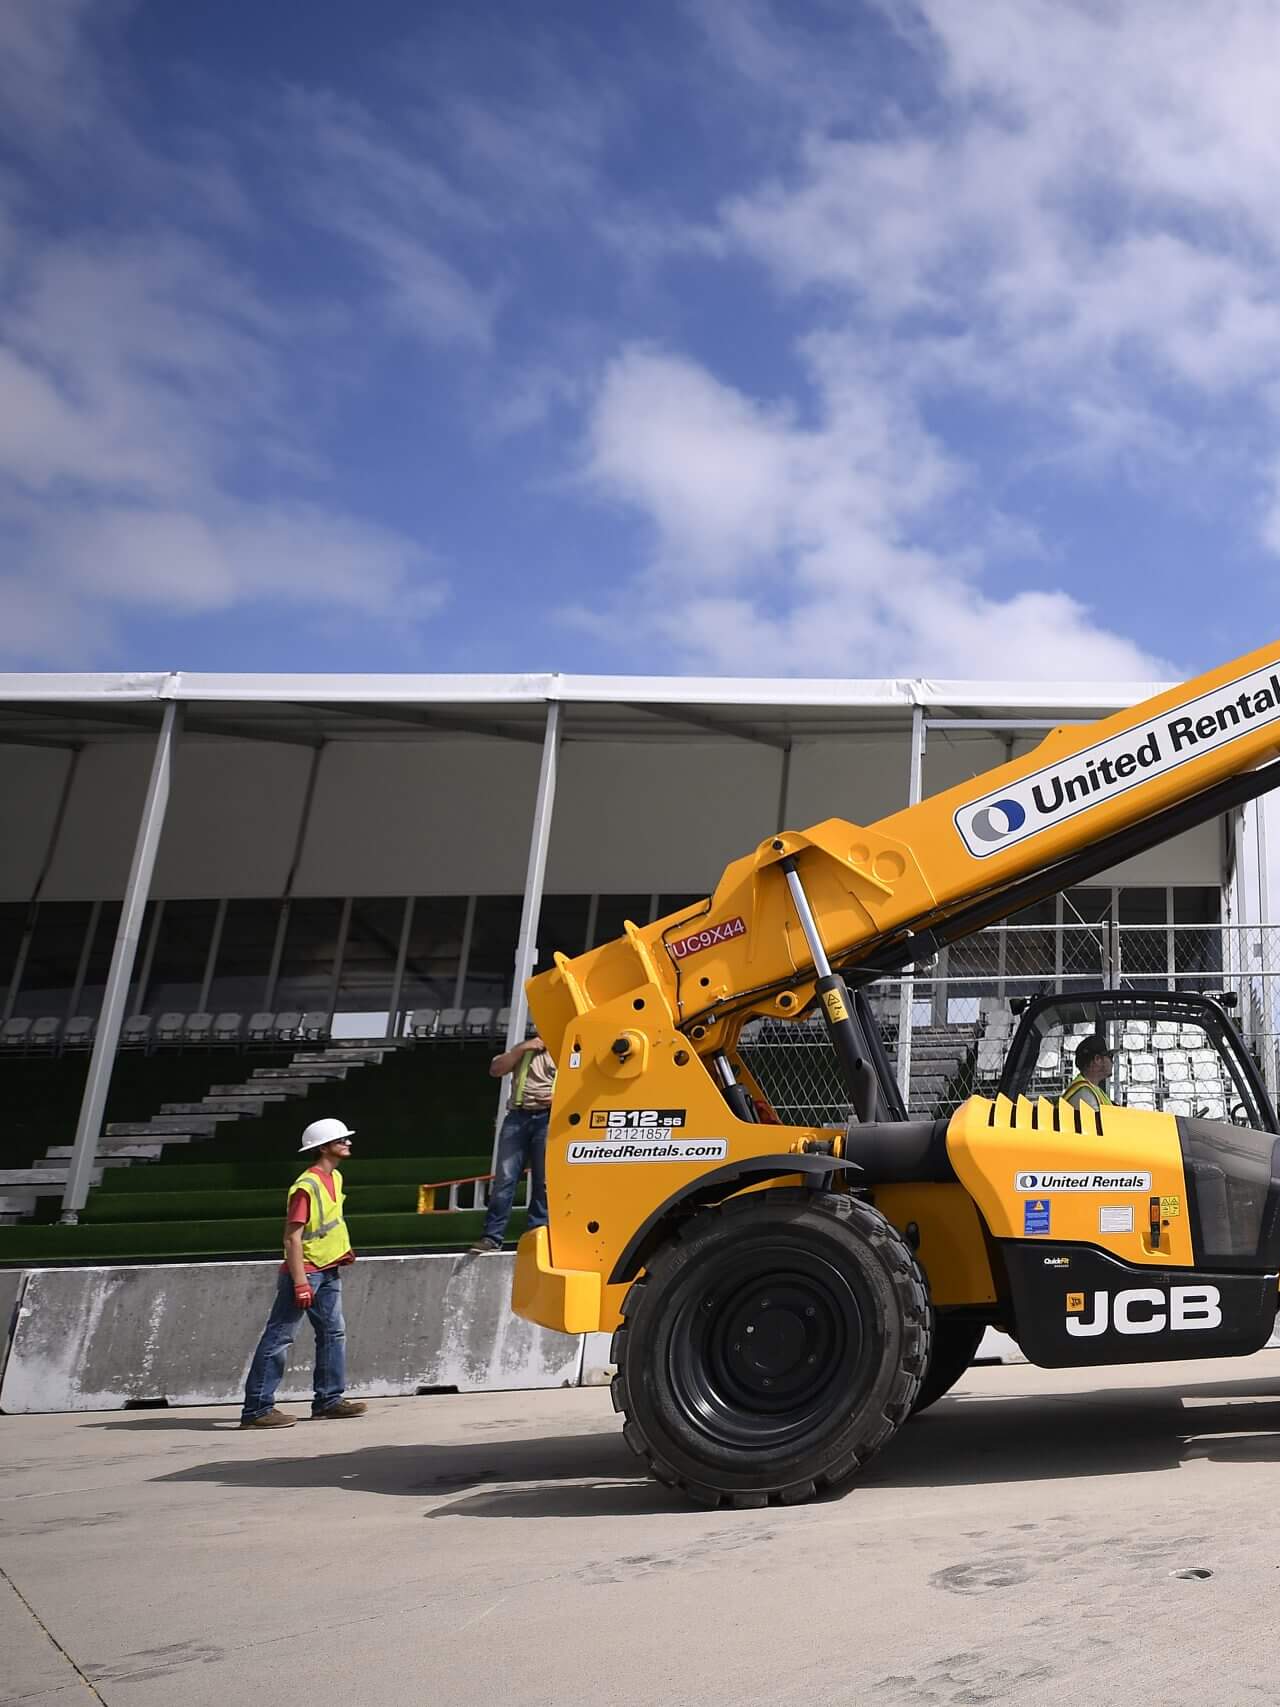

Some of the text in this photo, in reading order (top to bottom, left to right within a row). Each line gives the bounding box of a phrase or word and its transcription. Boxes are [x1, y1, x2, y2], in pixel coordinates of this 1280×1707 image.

[1032, 732, 1162, 814] United
[672, 919, 745, 957] UC9X44
[607, 1128, 670, 1140] 12121857
[572, 1144, 722, 1159] UnitedRentals.com
[1041, 1175, 1144, 1188] United Rentals
[1069, 1296, 1082, 1308] JCB
[1065, 1285, 1222, 1337] JCB
